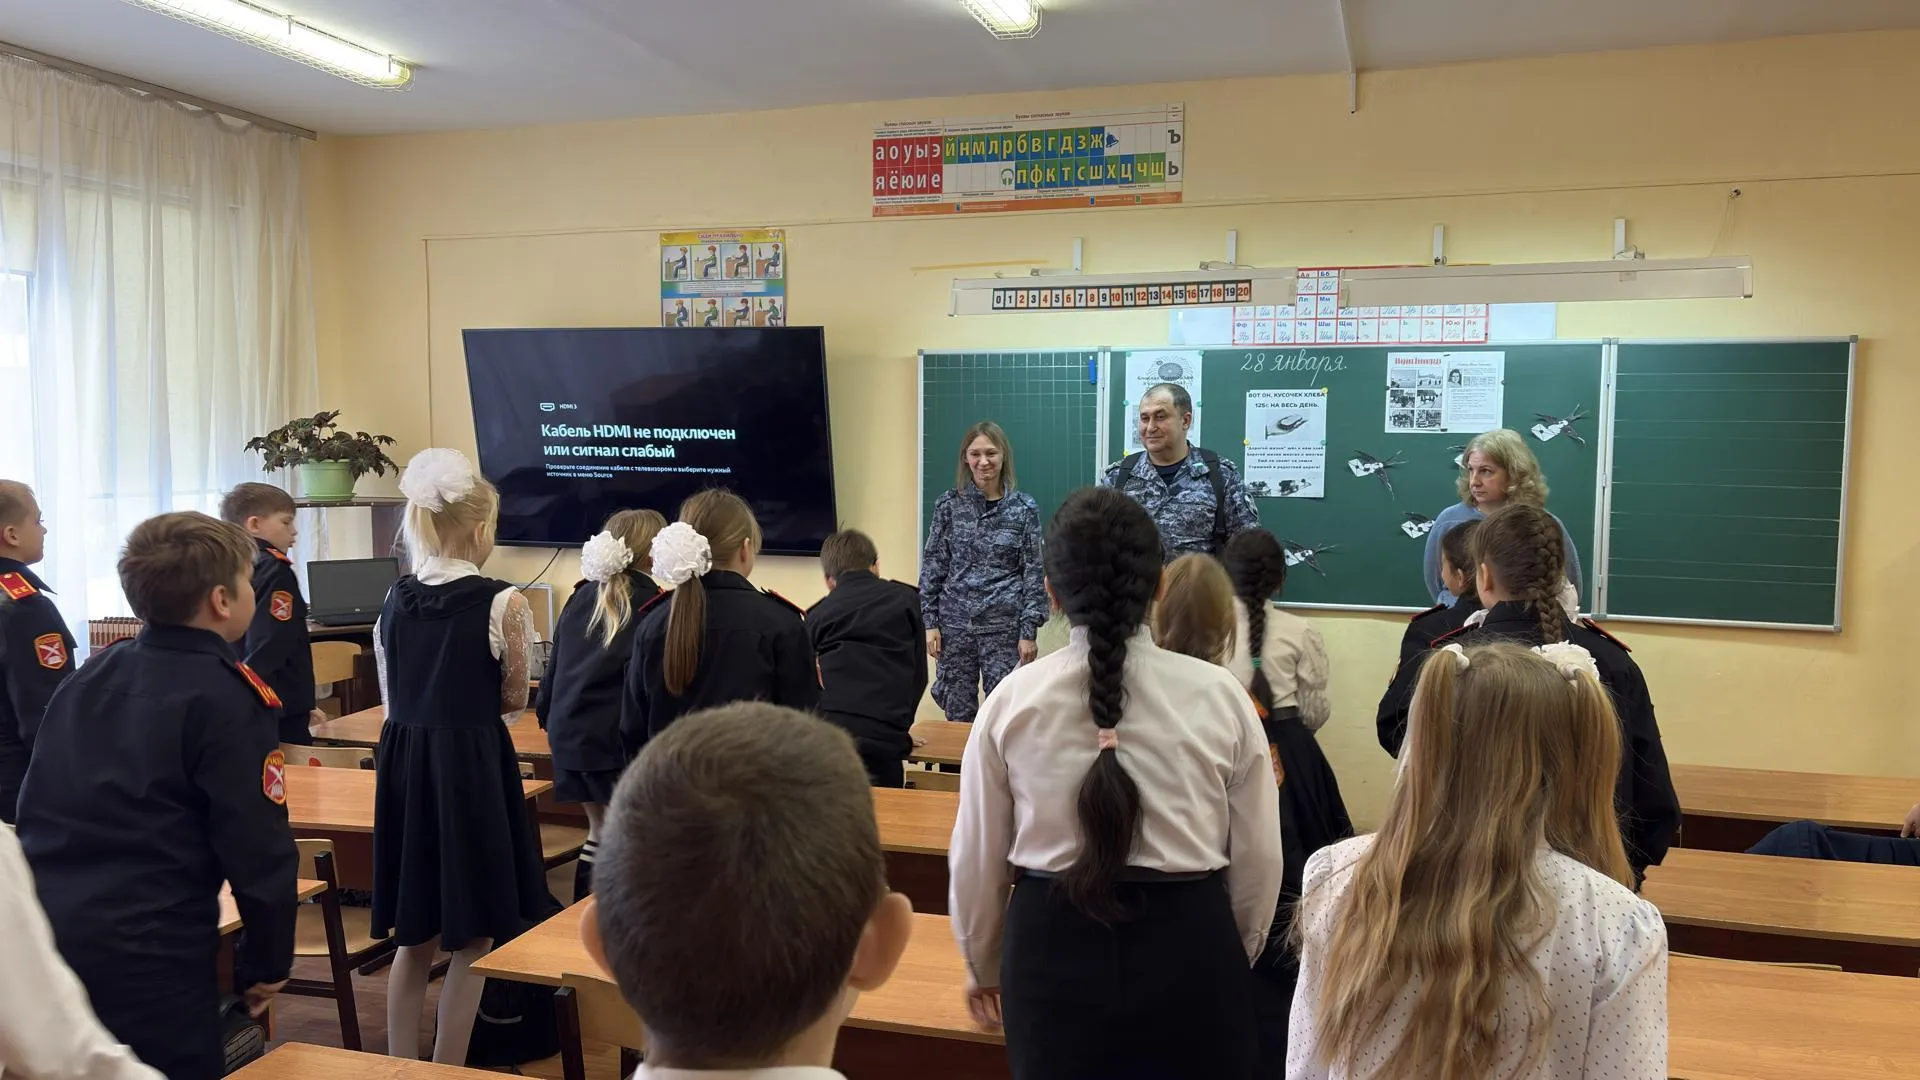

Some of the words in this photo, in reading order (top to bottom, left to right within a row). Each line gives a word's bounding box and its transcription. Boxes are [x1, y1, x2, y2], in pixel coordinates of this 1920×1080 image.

[995, 295, 1002, 304] 0
[1007, 295, 1013, 304] 1
[1018, 294, 1025, 303] 2
[1030, 294, 1037, 303] 3
[1042, 294, 1049, 303] 4
[1054, 294, 1060, 303] 5
[1066, 294, 1072, 302] 6
[1077, 293, 1084, 302] 7
[1089, 293, 1095, 302] 8
[1101, 293, 1107, 302] 9
[1111, 292, 1121, 302] 10
[1124, 292, 1134, 301] 11
[1136, 291, 1147, 301] 12
[1149, 291, 1159, 300] 13
[1161, 290, 1172, 299] 14
[1174, 289, 1184, 299] 15
[1186, 289, 1197, 298] 16
[1199, 288, 1210, 298] 17
[1212, 288, 1222, 297] 18
[1225, 287, 1236, 297] 19
[1237, 286, 1249, 296] 20
[1240, 353, 1265, 372] 28
[1270, 348, 1347, 387] января.
[541, 423, 591, 438] Кабель
[593, 424, 631, 438] HDMI
[634, 428, 650, 439] не
[653, 427, 736, 441] подключен
[544, 445, 569, 456] или
[572, 446, 619, 457] сигнал
[621, 443, 675, 458] слабый
[707, 466, 731, 474] нужный
